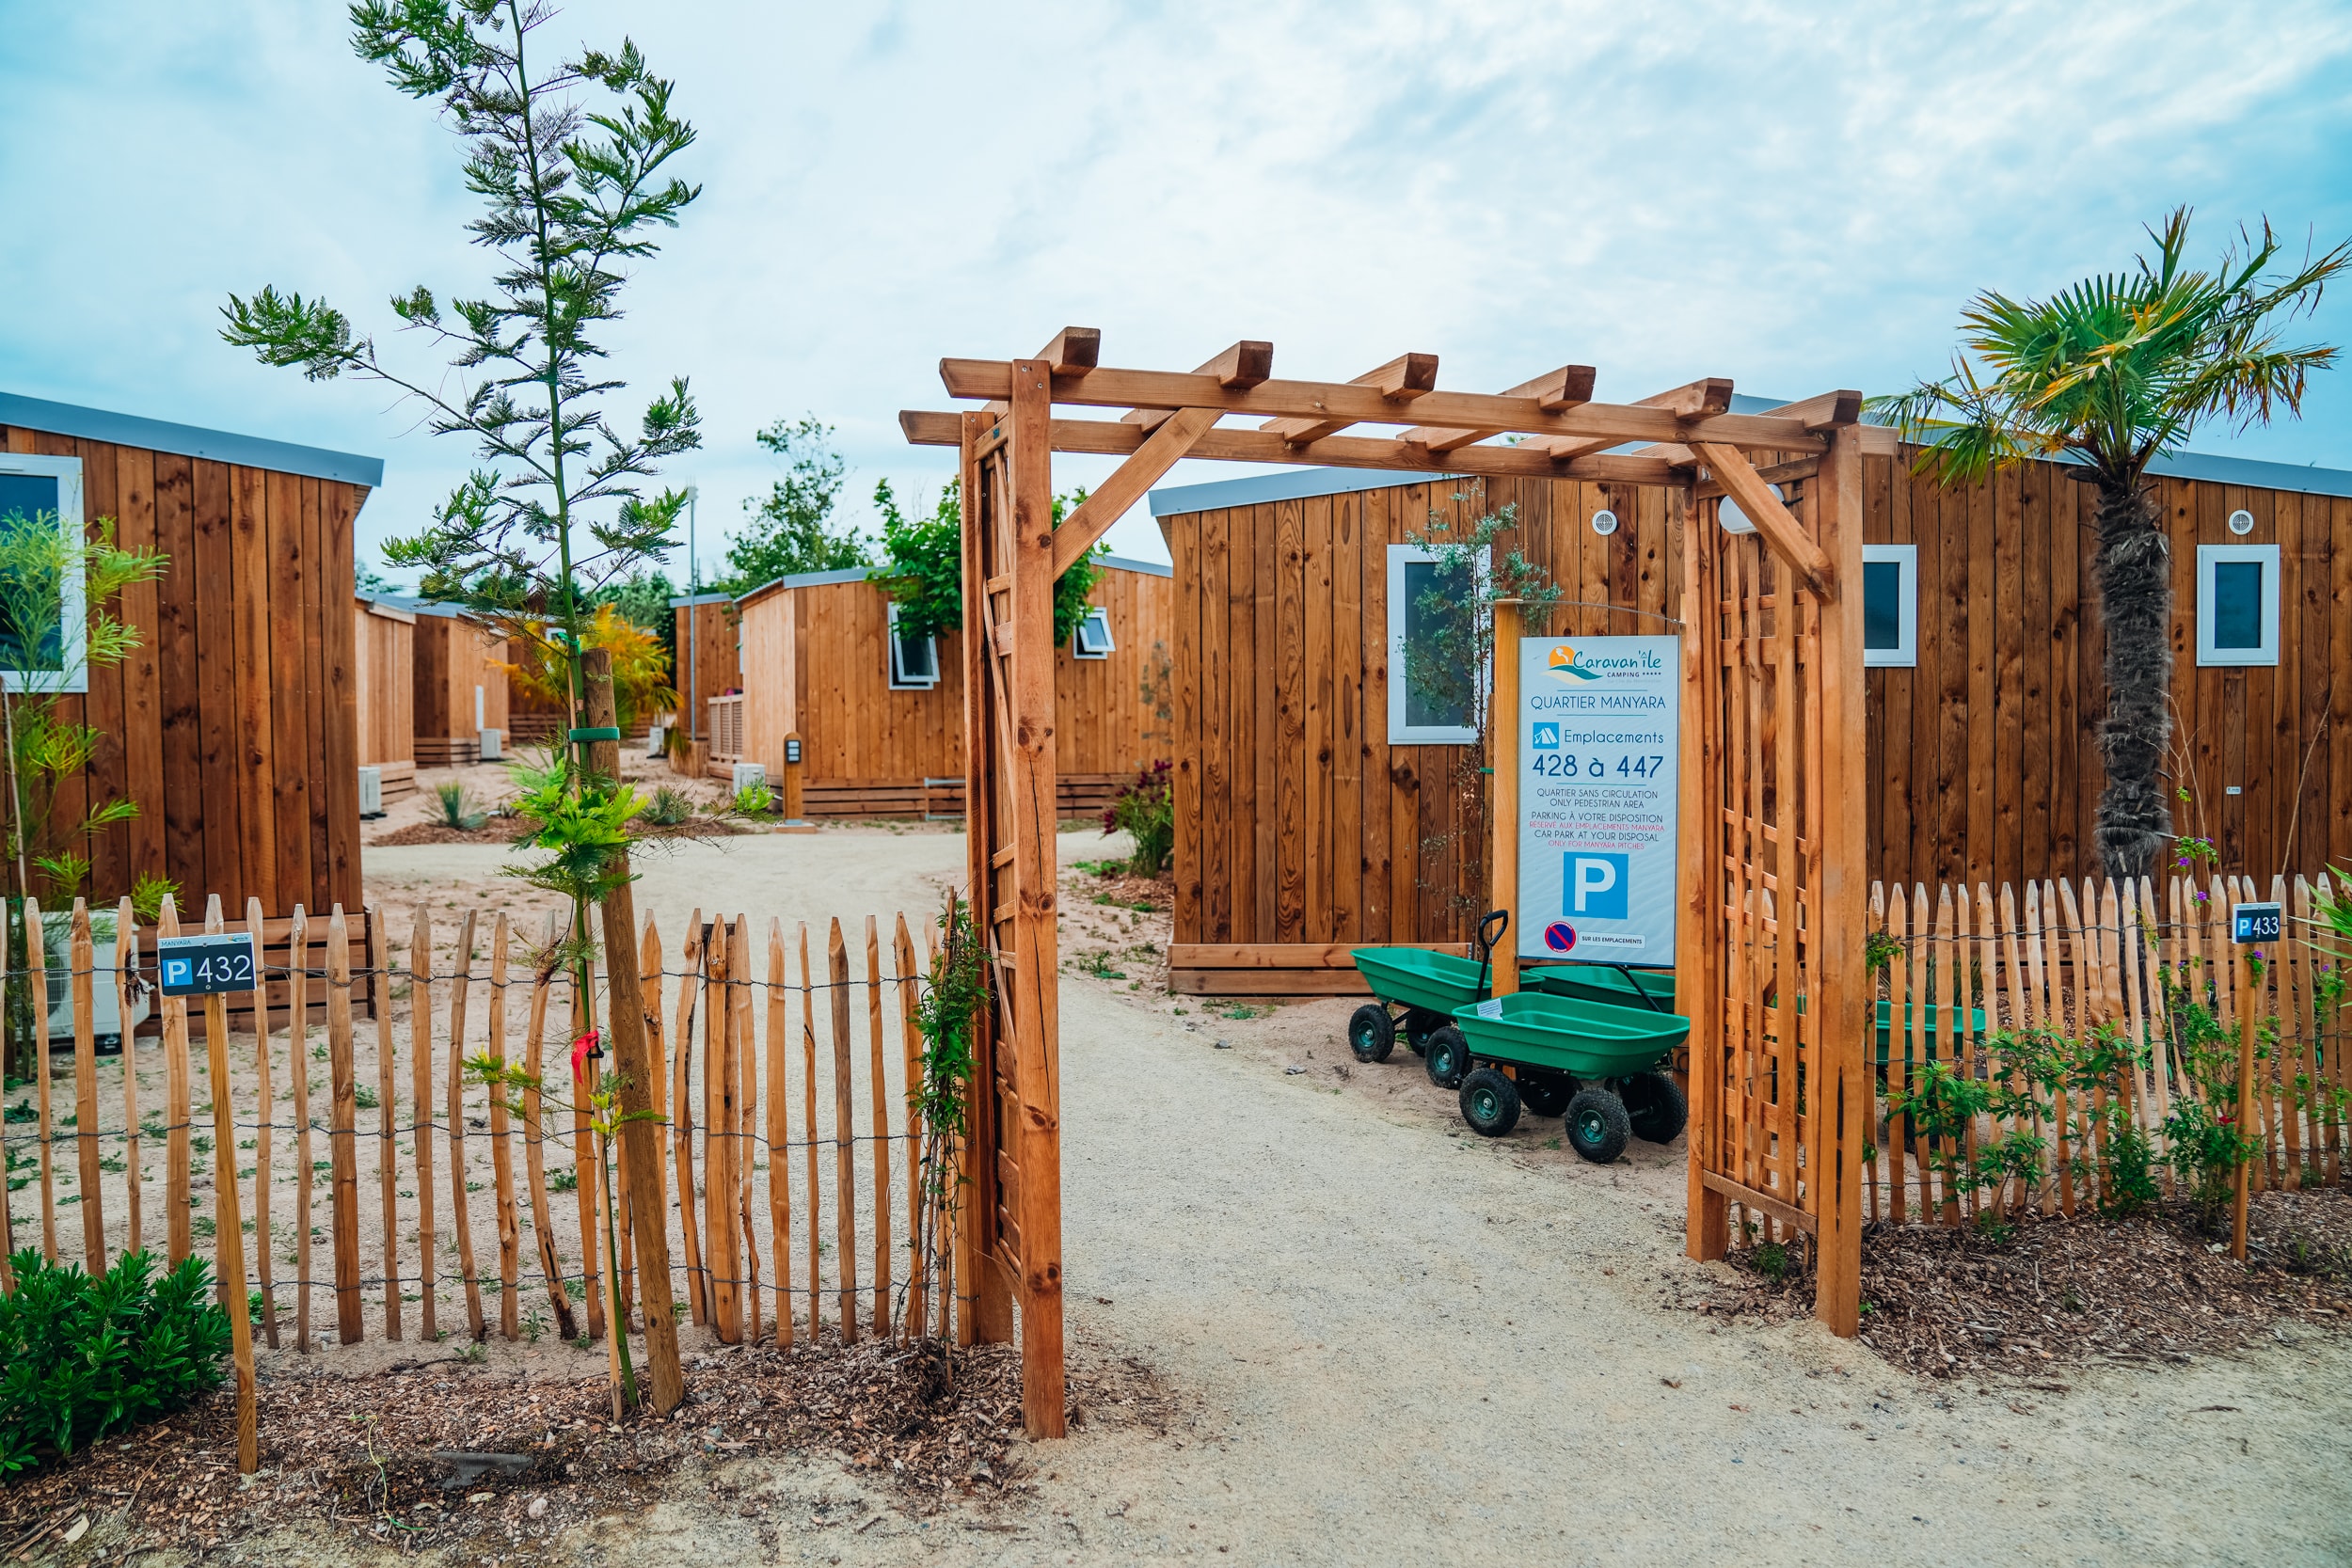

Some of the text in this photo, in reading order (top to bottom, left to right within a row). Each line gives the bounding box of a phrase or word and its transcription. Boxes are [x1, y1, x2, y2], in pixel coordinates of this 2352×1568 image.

[1531, 696, 1666, 709] QUARTIER MANYARA
[1565, 730, 1664, 745] Emplacements
[1532, 754, 1664, 778] 428 à 447
[1536, 788, 1659, 799] QUARTIER SANS CIRCULATION
[1549, 798, 1645, 809] ONLY PEDESTRIAN AREA
[1531, 811, 1566, 821] PARKING
[1578, 813, 1606, 822] VOTRE
[1609, 813, 1663, 823] DISPOSITION
[1559, 821, 1573, 830] AUX
[1575, 822, 1629, 831] EMPLACEMENTS
[1534, 830, 1660, 842] CAR PARK AT YOUR DISPOSAL
[1574, 858, 1616, 911] P
[2239, 916, 2280, 935] P 433
[161, 940, 192, 948] MANYARA
[167, 955, 252, 984] P 432
